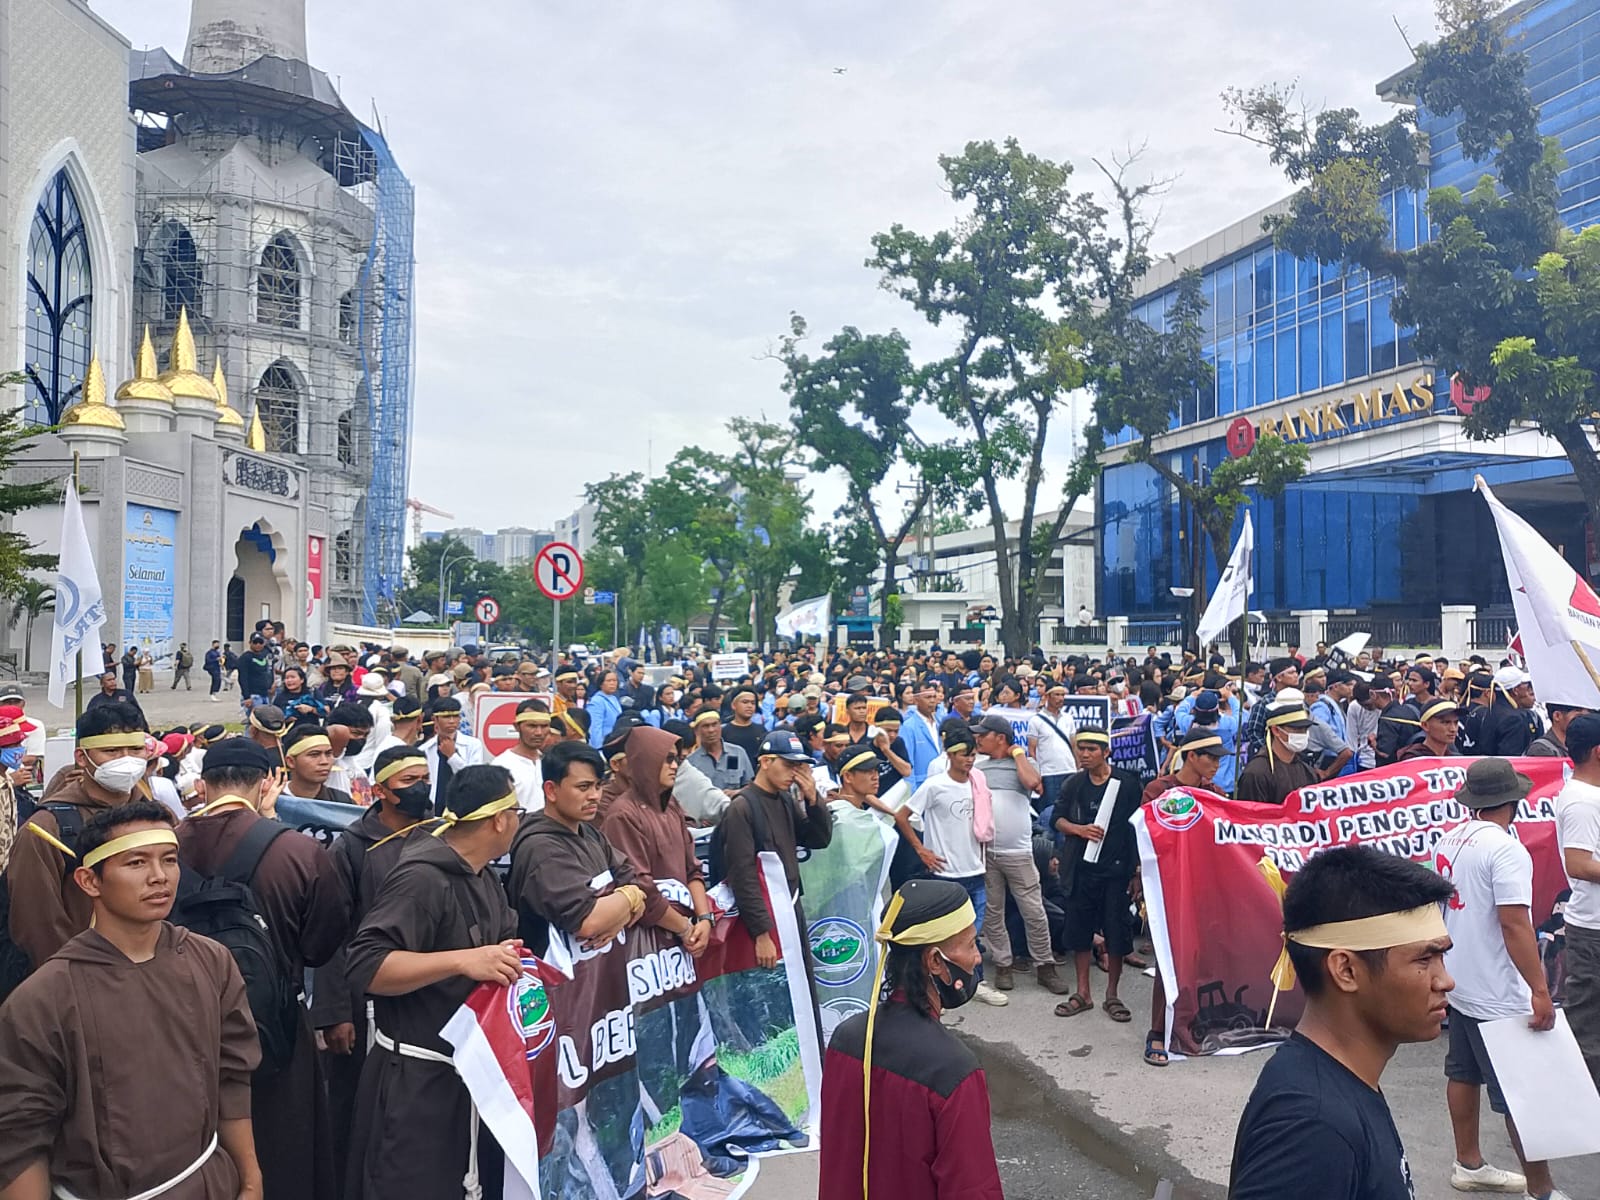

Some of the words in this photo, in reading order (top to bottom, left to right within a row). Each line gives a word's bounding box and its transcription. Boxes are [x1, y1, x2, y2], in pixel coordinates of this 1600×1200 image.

[1258, 397, 1346, 442] BANK
[1352, 373, 1434, 426] MAS
[128, 564, 166, 582] Selamat
[552, 553, 571, 591] P
[1111, 734, 1146, 748] UMUT
[1111, 745, 1147, 760] AKUT
[1302, 777, 1413, 810] PRINSIP
[1423, 769, 1467, 790] TP
[1217, 819, 1329, 845] MENJADI
[1340, 801, 1464, 839] PENGECU
